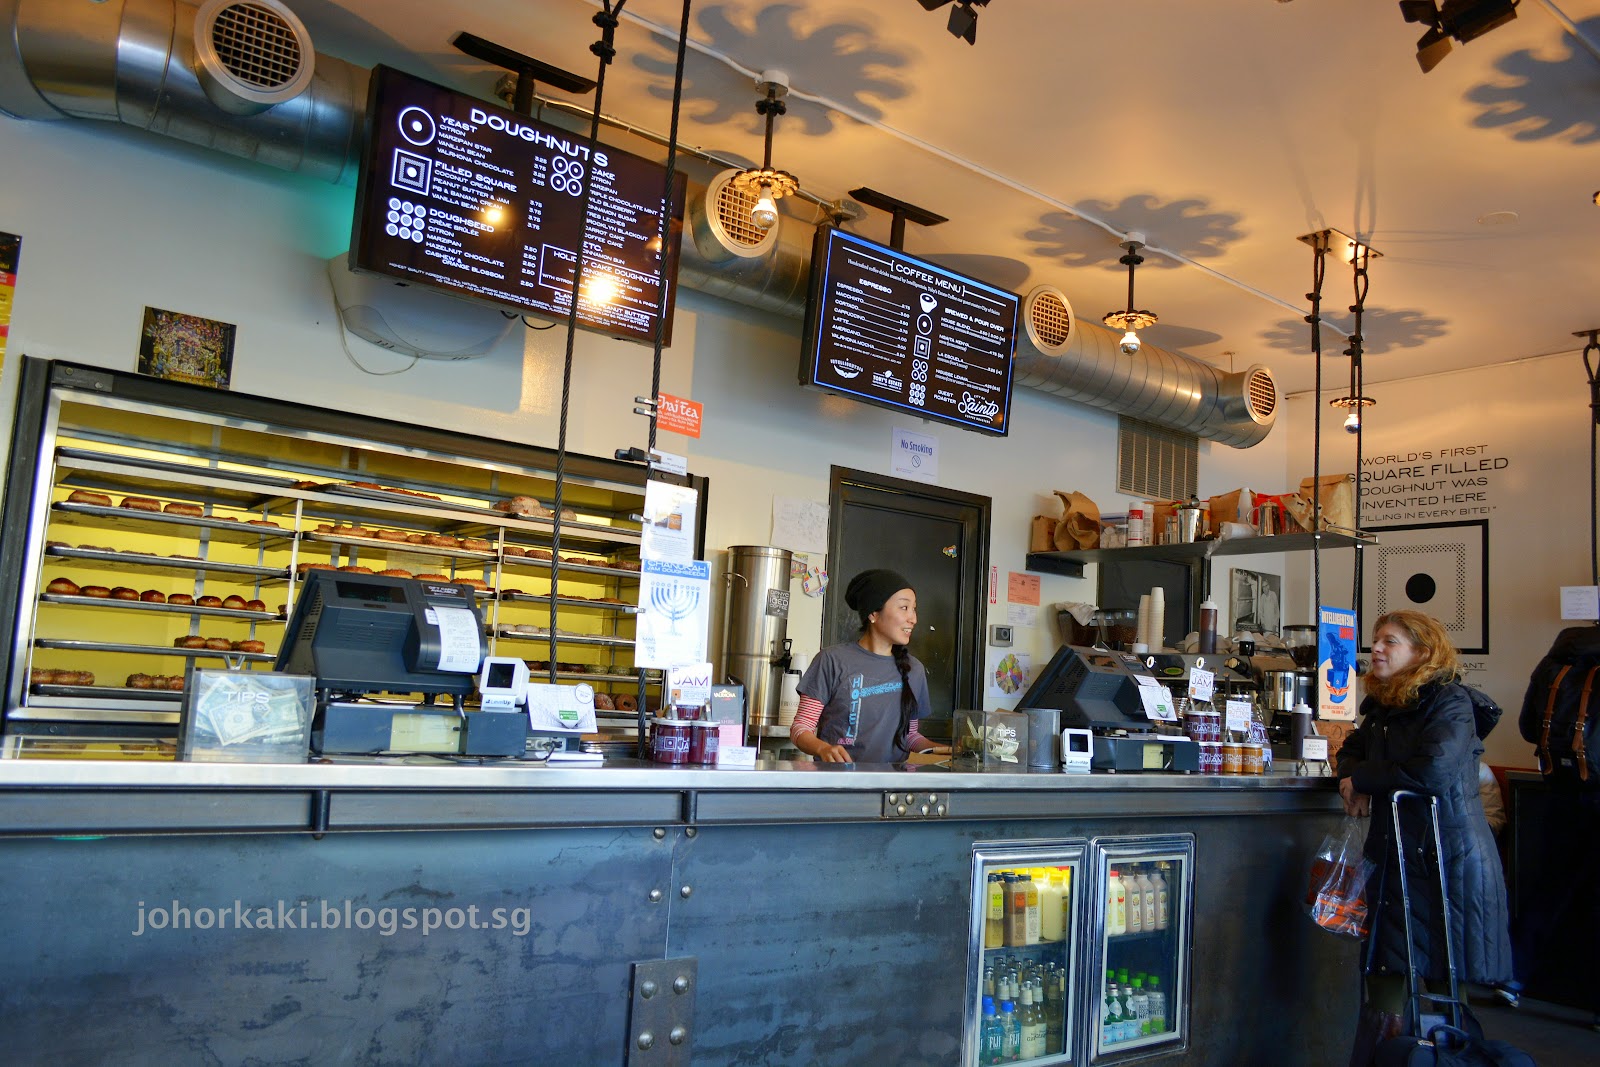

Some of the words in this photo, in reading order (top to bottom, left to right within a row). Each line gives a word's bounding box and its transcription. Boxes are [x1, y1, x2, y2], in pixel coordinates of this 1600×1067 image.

[439, 124, 466, 137] CITRON
[441, 115, 478, 133] YEAST
[470, 108, 609, 167] DOUGHNUTS
[438, 140, 465, 153] VANILLA
[467, 149, 485, 159] BEAN
[439, 132, 473, 147] MARZIPAN
[474, 143, 492, 154] STAR
[533, 163, 546, 172] 3.75
[437, 147, 472, 163] VALRHONA
[474, 160, 515, 177] CHOCOLATE
[434, 169, 468, 183] COCONUT
[469, 181, 493, 191] CREAM
[435, 160, 472, 178] FILLED
[475, 174, 517, 193] SQUARE
[433, 177, 460, 189] PEANUT
[462, 186, 488, 198] BUTTER
[496, 197, 510, 205] JAM
[431, 193, 459, 206] VANILLA
[461, 201, 480, 212] BEAN
[450, 190, 478, 203] BANANA
[479, 199, 503, 210] CREAM
[608, 196, 643, 212] CHOCOLATE
[644, 207, 658, 216] MINT
[603, 202, 636, 216] BLUEBERRY
[429, 208, 494, 233] DOUGHSEED
[602, 216, 626, 227] LECHES
[618, 213, 637, 223] SUGAR
[428, 226, 455, 237] CITRON
[609, 233, 625, 242] CAKE
[618, 228, 648, 242] BLACKOUT
[426, 234, 462, 247] MARZIPAN
[583, 241, 603, 252] ETC.
[607, 240, 623, 248] CAKE
[425, 241, 462, 256] HAZELNUT
[464, 252, 504, 268] CHOCOLATE
[425, 249, 455, 261] CASHEW
[613, 257, 625, 265] BUN
[442, 260, 470, 271] ORANGE
[471, 266, 504, 280] BLOSSOM
[590, 262, 612, 273] CAKE
[896, 264, 934, 284] COFFEE
[935, 278, 961, 293] MENU
[837, 282, 863, 294] ESPRESSO
[859, 278, 892, 294] ESPRESSO
[836, 290, 864, 303] MACCHIATO
[835, 299, 858, 310] CORTADO
[625, 309, 650, 320] BUTTER
[833, 316, 849, 324] LATTE
[834, 307, 865, 321] CAPPUCCINO
[945, 307, 968, 320] BREWED
[974, 318, 989, 327] POUR
[990, 323, 1004, 332] OVER
[832, 324, 861, 337] AMERICANO
[933, 394, 956, 404] ROASTER
[938, 390, 953, 398] GUEST
[680, 401, 699, 419] Tea
[958, 391, 999, 416] Saints
[901, 439, 908, 449] No
[910, 441, 932, 456] Smoking
[1360, 450, 1433, 467] WORLD'S
[1440, 444, 1488, 458] FIRST
[1431, 457, 1509, 476] FILLED
[1360, 480, 1448, 497] DOUGHNUT
[1451, 476, 1488, 489] WAS
[1361, 495, 1439, 511] INVENTED
[1443, 491, 1487, 504] HERE
[1403, 512, 1416, 520] IN
[1417, 509, 1456, 519] EVERY
[662, 568, 706, 577] DOUGHSEEDS
[770, 597, 788, 605] ICED
[673, 676, 708, 686] JAM
[1191, 678, 1212, 688] JAM
[1192, 672, 1212, 681] PLANT
[223, 691, 270, 704] TIPS
[846, 677, 860, 738] HOTEL
[997, 729, 1016, 737] TIPS
[989, 1036, 1001, 1048] FIJI
[1010, 1033, 1020, 1045] FIJI
